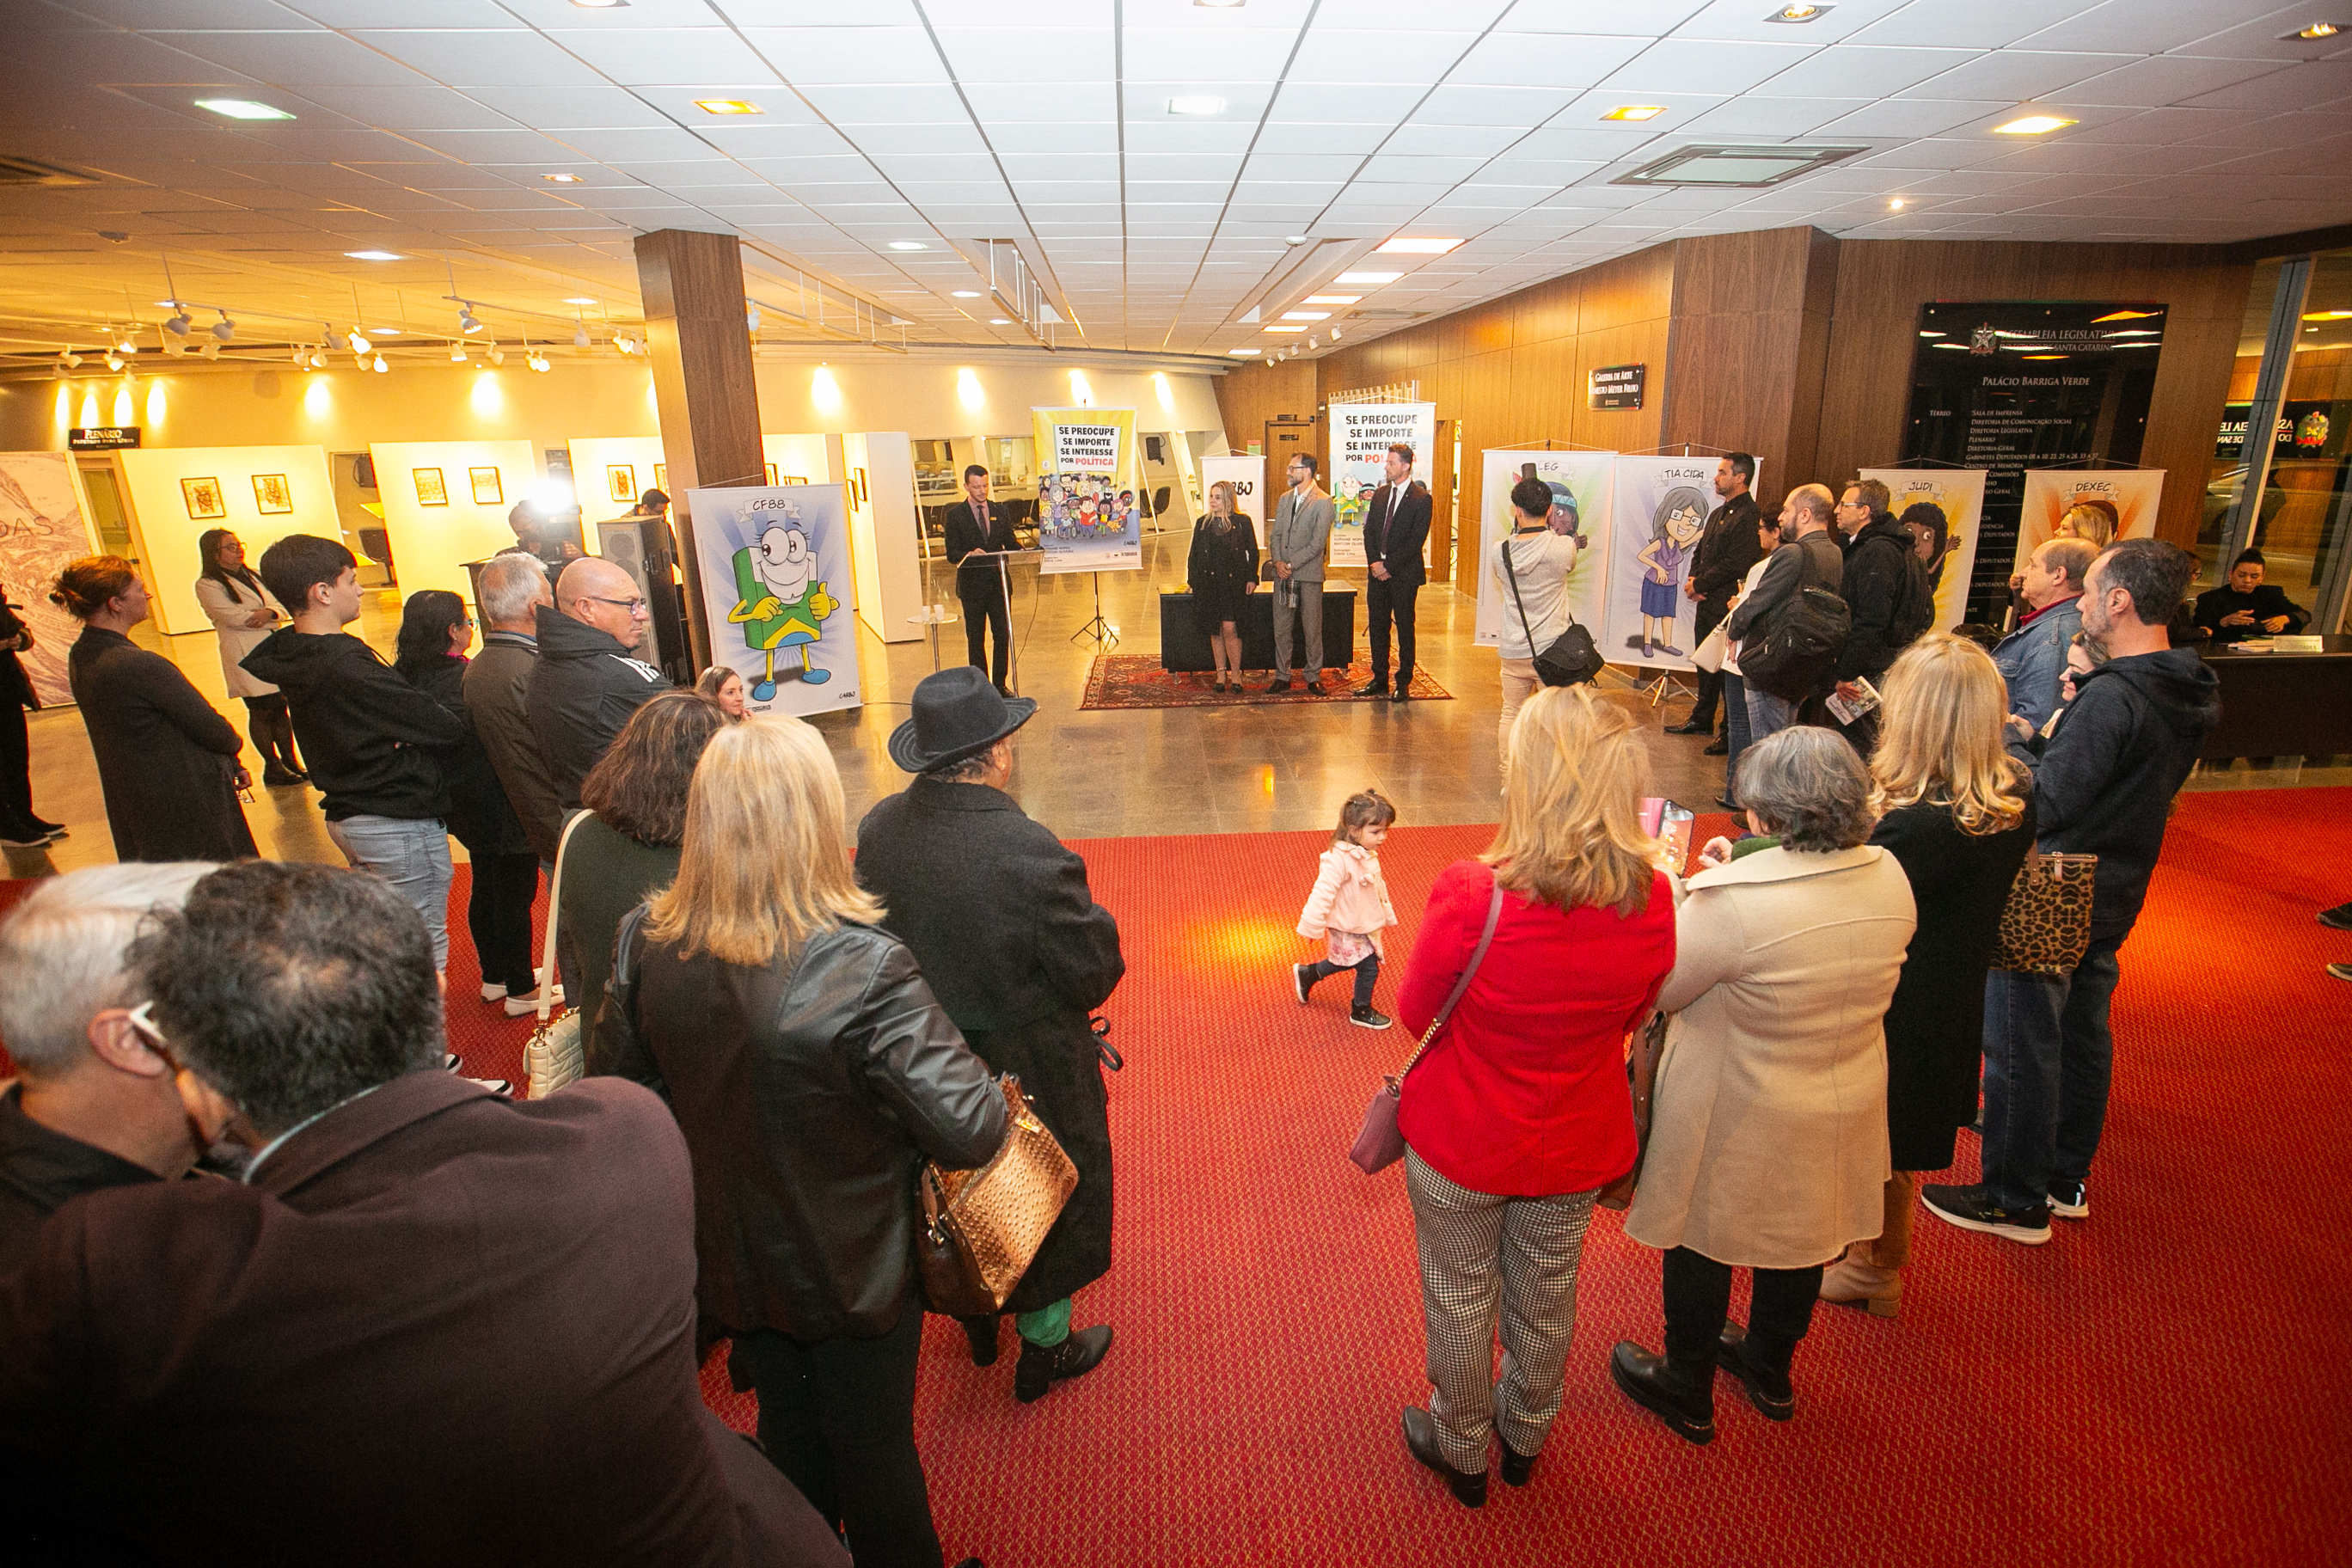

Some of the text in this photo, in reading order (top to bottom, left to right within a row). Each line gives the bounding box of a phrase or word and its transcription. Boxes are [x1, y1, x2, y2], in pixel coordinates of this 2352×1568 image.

[1620, 371, 1633, 380] ARTE
[1982, 376, 2090, 386] PALÁCIO BARRIGA VERDE
[1346, 415, 1418, 424] SE PREOCUPE
[1072, 427, 1115, 435] PREOCUPE
[1350, 429, 1413, 438] SE IMPORTE
[1346, 441, 1358, 450] SE
[1075, 456, 1114, 466] POLÍTICA
[1665, 470, 1704, 480] TIA CIDA
[1909, 481, 1932, 492] JUDI
[2076, 482, 2111, 492] DEXEC
[753, 499, 785, 510] CF88
